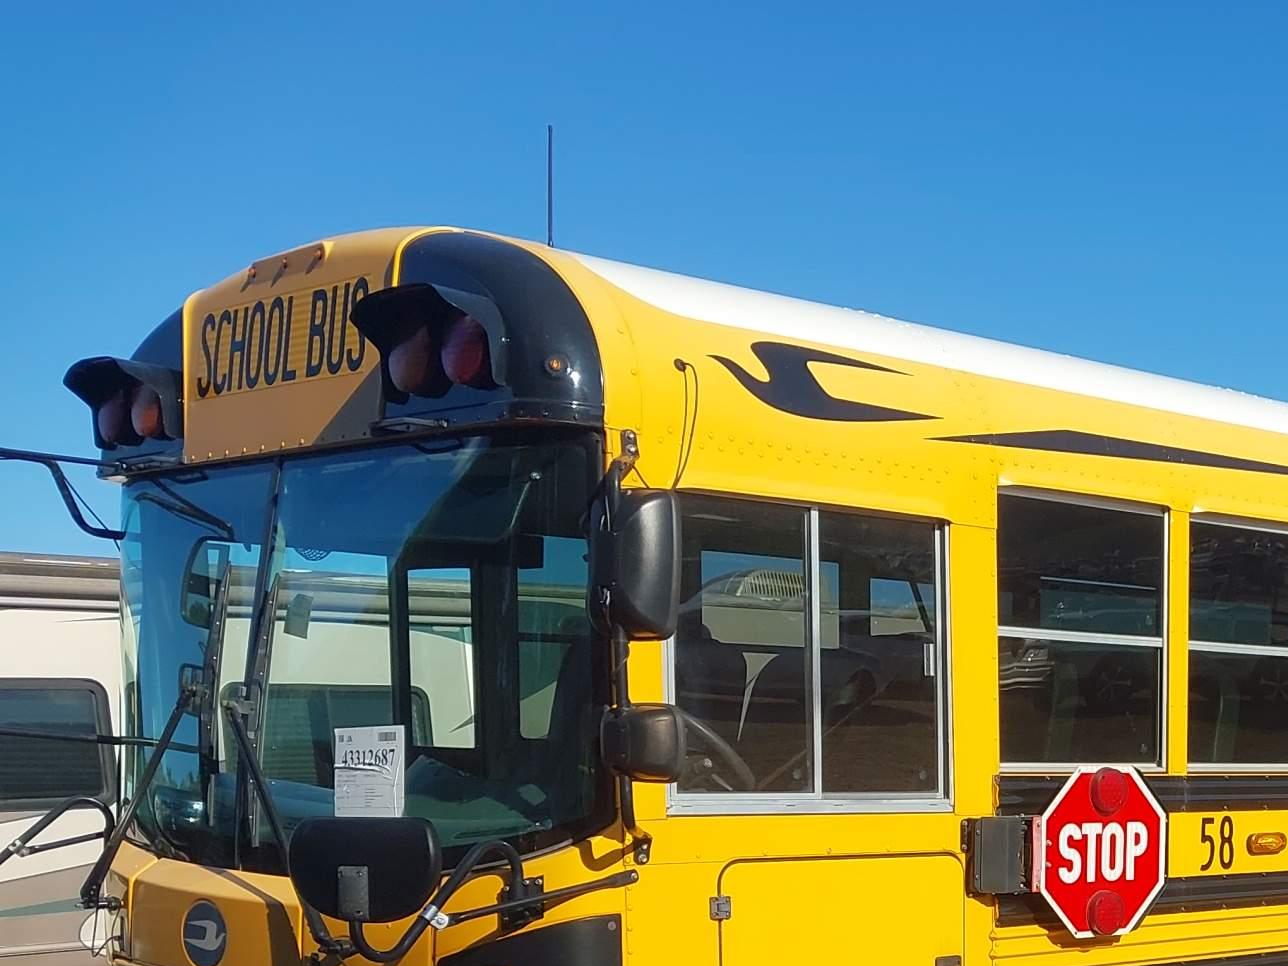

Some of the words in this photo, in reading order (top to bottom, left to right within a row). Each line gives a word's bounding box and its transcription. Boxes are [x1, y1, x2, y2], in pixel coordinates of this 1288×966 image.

[197, 296, 296, 398] SCHOOL
[306, 277, 369, 378] BUS
[341, 748, 396, 767] 43312687
[1058, 821, 1148, 885] STOP
[1200, 815, 1234, 872] 58
